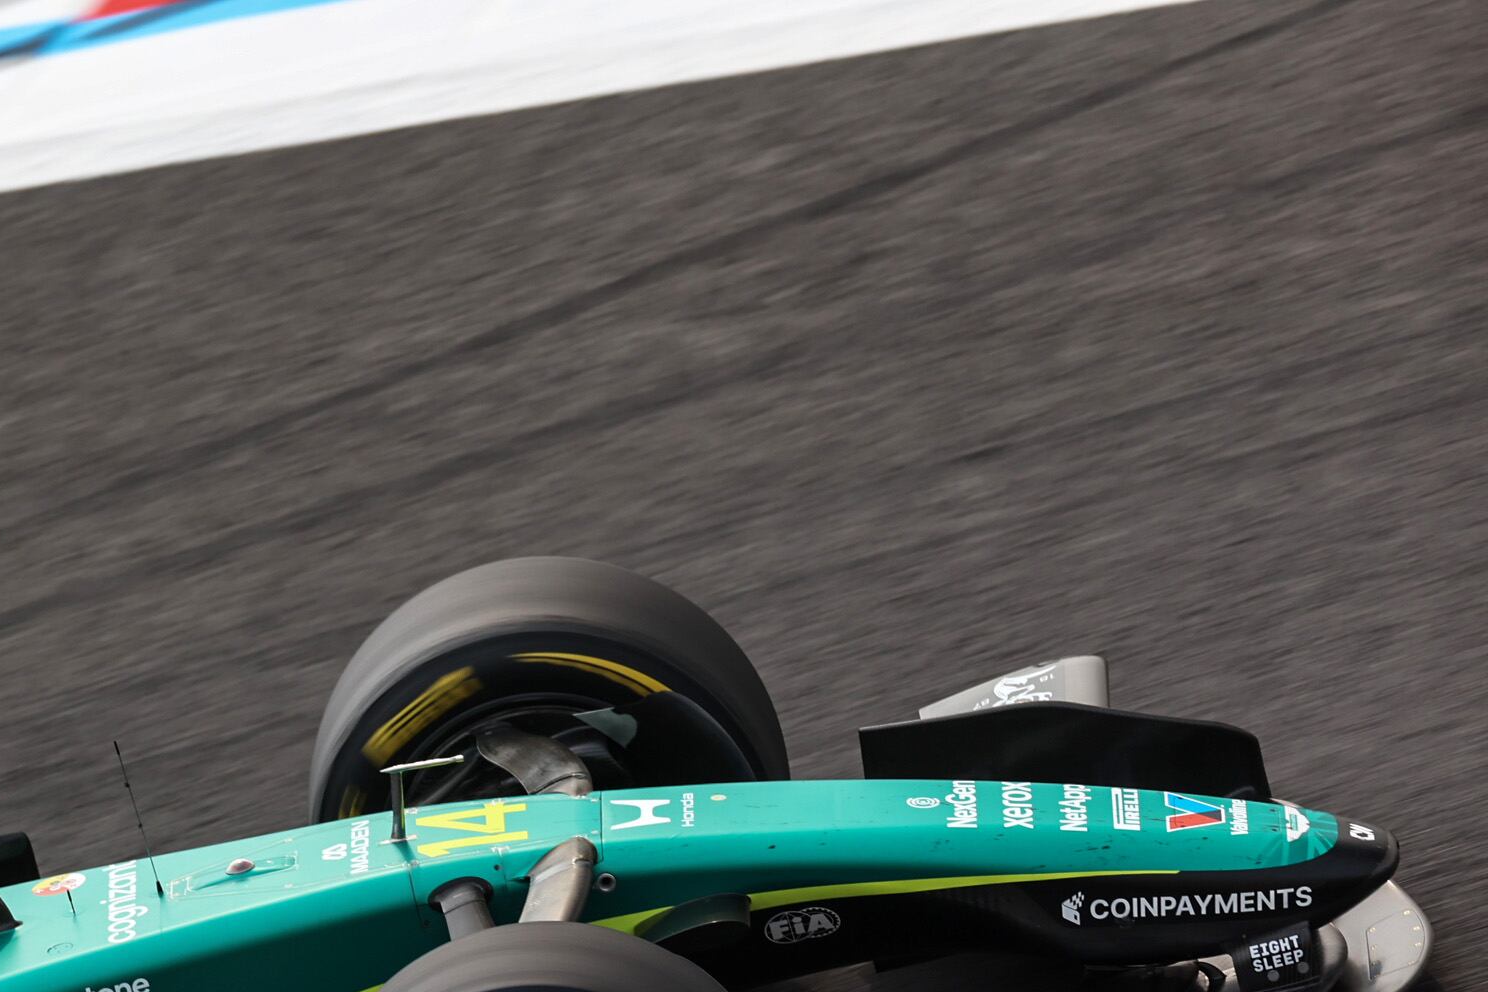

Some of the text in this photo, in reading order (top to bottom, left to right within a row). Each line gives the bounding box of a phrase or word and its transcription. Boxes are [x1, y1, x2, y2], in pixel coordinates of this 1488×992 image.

[681, 793, 694, 828] Honda
[945, 780, 978, 829] NexGen
[1001, 782, 1034, 829] xerox
[1059, 784, 1092, 832] NetApp
[1112, 787, 1140, 831] PIRELLI
[351, 820, 369, 875] MAADEN
[415, 803, 528, 859] 14
[1090, 886, 1313, 920] COINPAYMENTS
[1249, 935, 1300, 959] EIGHT
[1252, 949, 1304, 973] SLEEP
